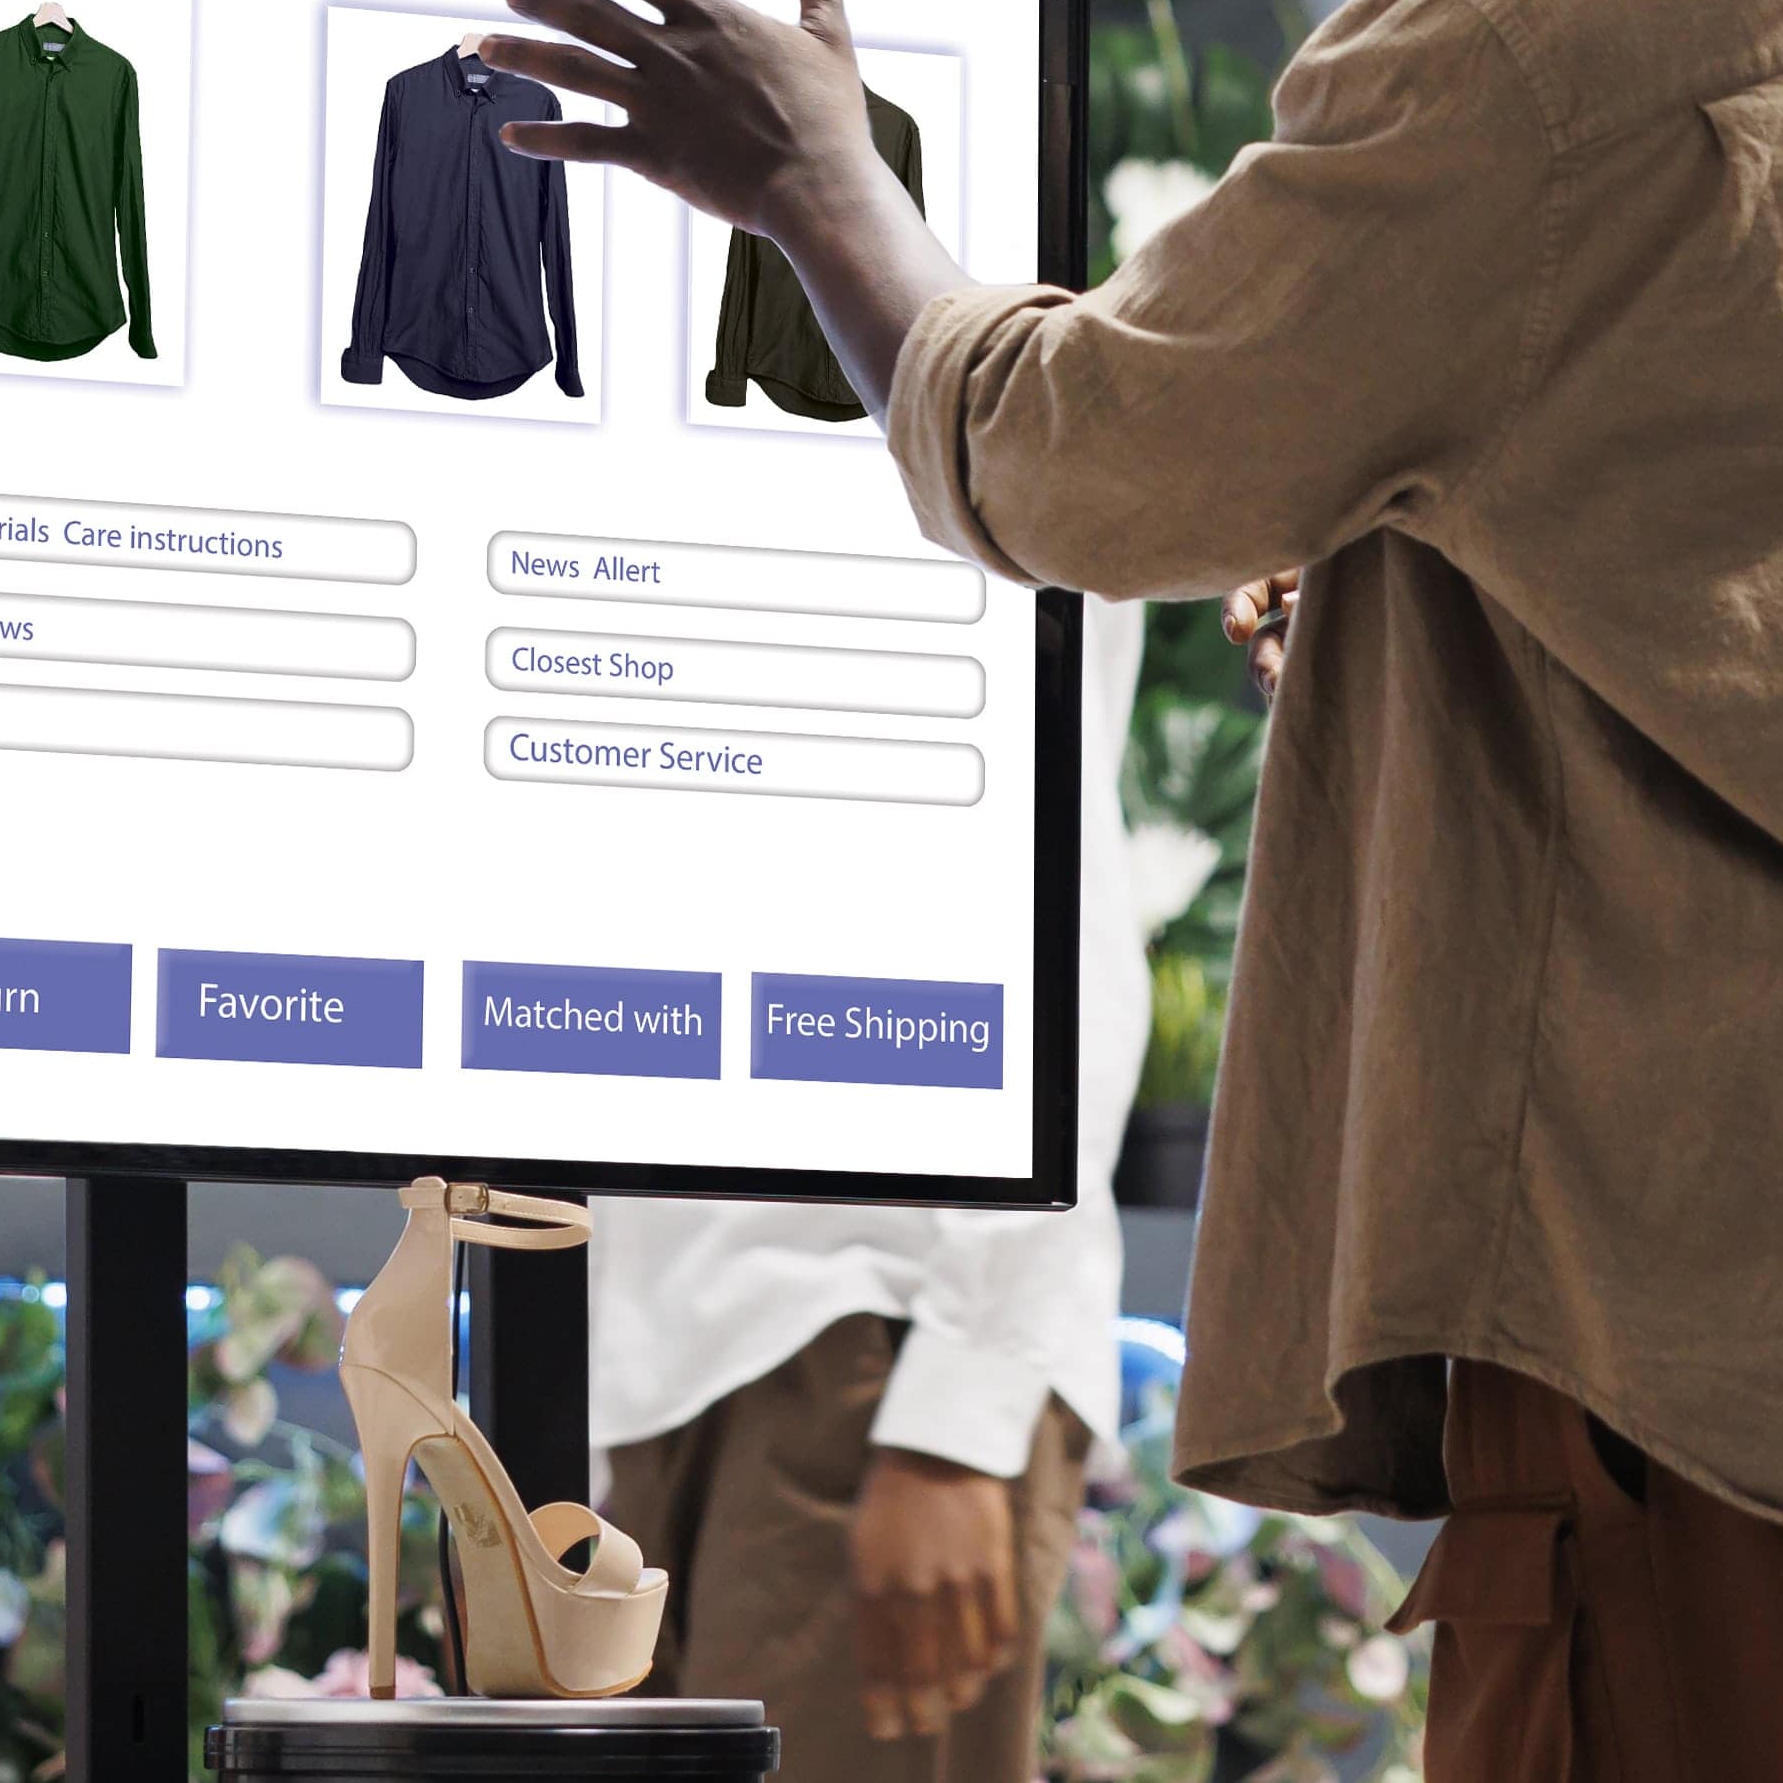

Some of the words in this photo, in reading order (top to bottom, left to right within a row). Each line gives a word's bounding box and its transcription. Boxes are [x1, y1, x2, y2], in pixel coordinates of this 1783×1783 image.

[63, 520, 122, 548] Care
[130, 524, 283, 559] instructions
[511, 550, 580, 579] News
[593, 555, 661, 584] Allert
[511, 646, 602, 676] Closest
[609, 652, 674, 687] Shop
[509, 732, 652, 769] Customer
[659, 741, 763, 775] Service
[200, 983, 344, 1023] Favorite
[484, 996, 623, 1032] Matched
[633, 1003, 702, 1036] with
[768, 1003, 836, 1037] Free
[845, 1006, 989, 1053] Shipping
